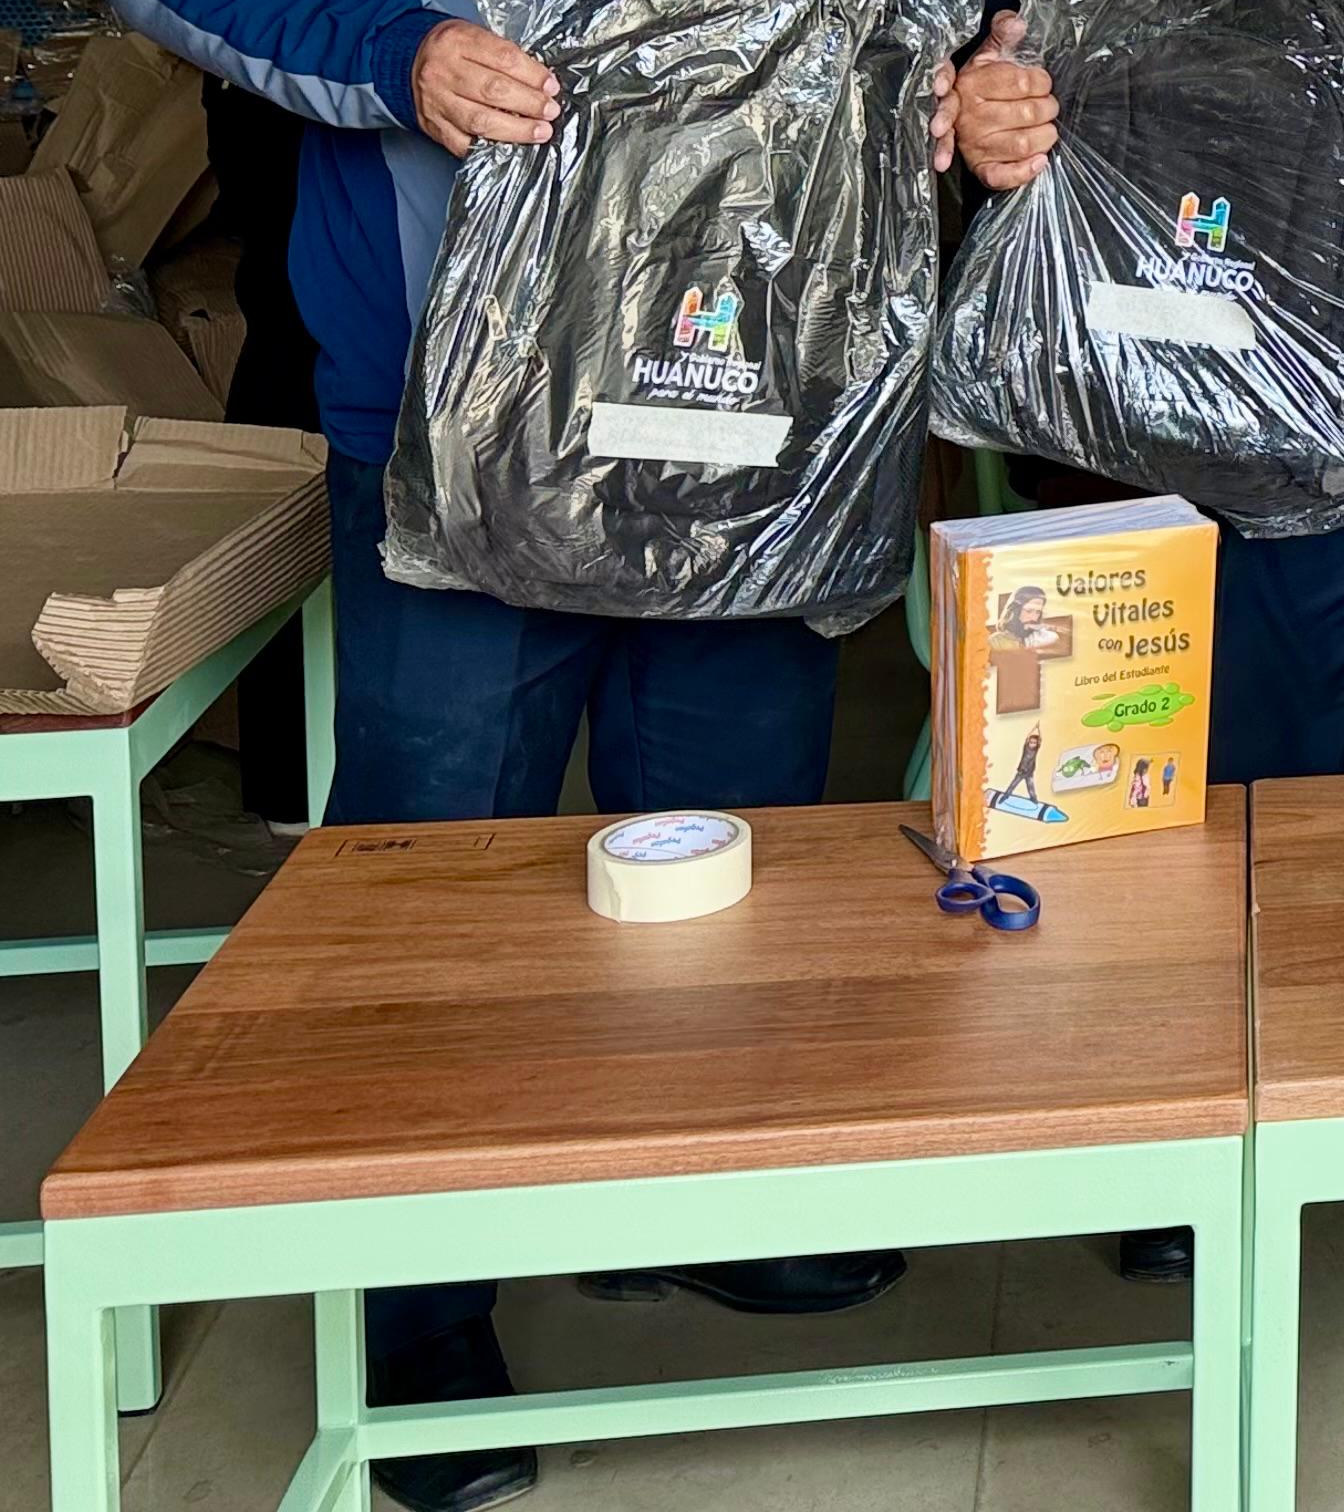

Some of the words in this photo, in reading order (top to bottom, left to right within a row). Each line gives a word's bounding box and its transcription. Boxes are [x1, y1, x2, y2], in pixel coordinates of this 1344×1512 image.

[1056, 568, 1146, 596] Valores
[1093, 598, 1174, 627] Vitales
[1098, 637, 1123, 651] con
[1126, 628, 1190, 659] Jesús
[1074, 674, 1100, 687] Libro
[1102, 670, 1118, 684] del
[1119, 664, 1170, 680] Estudiante
[1114, 698, 1158, 719] Grado
[1161, 696, 1170, 712] 2
